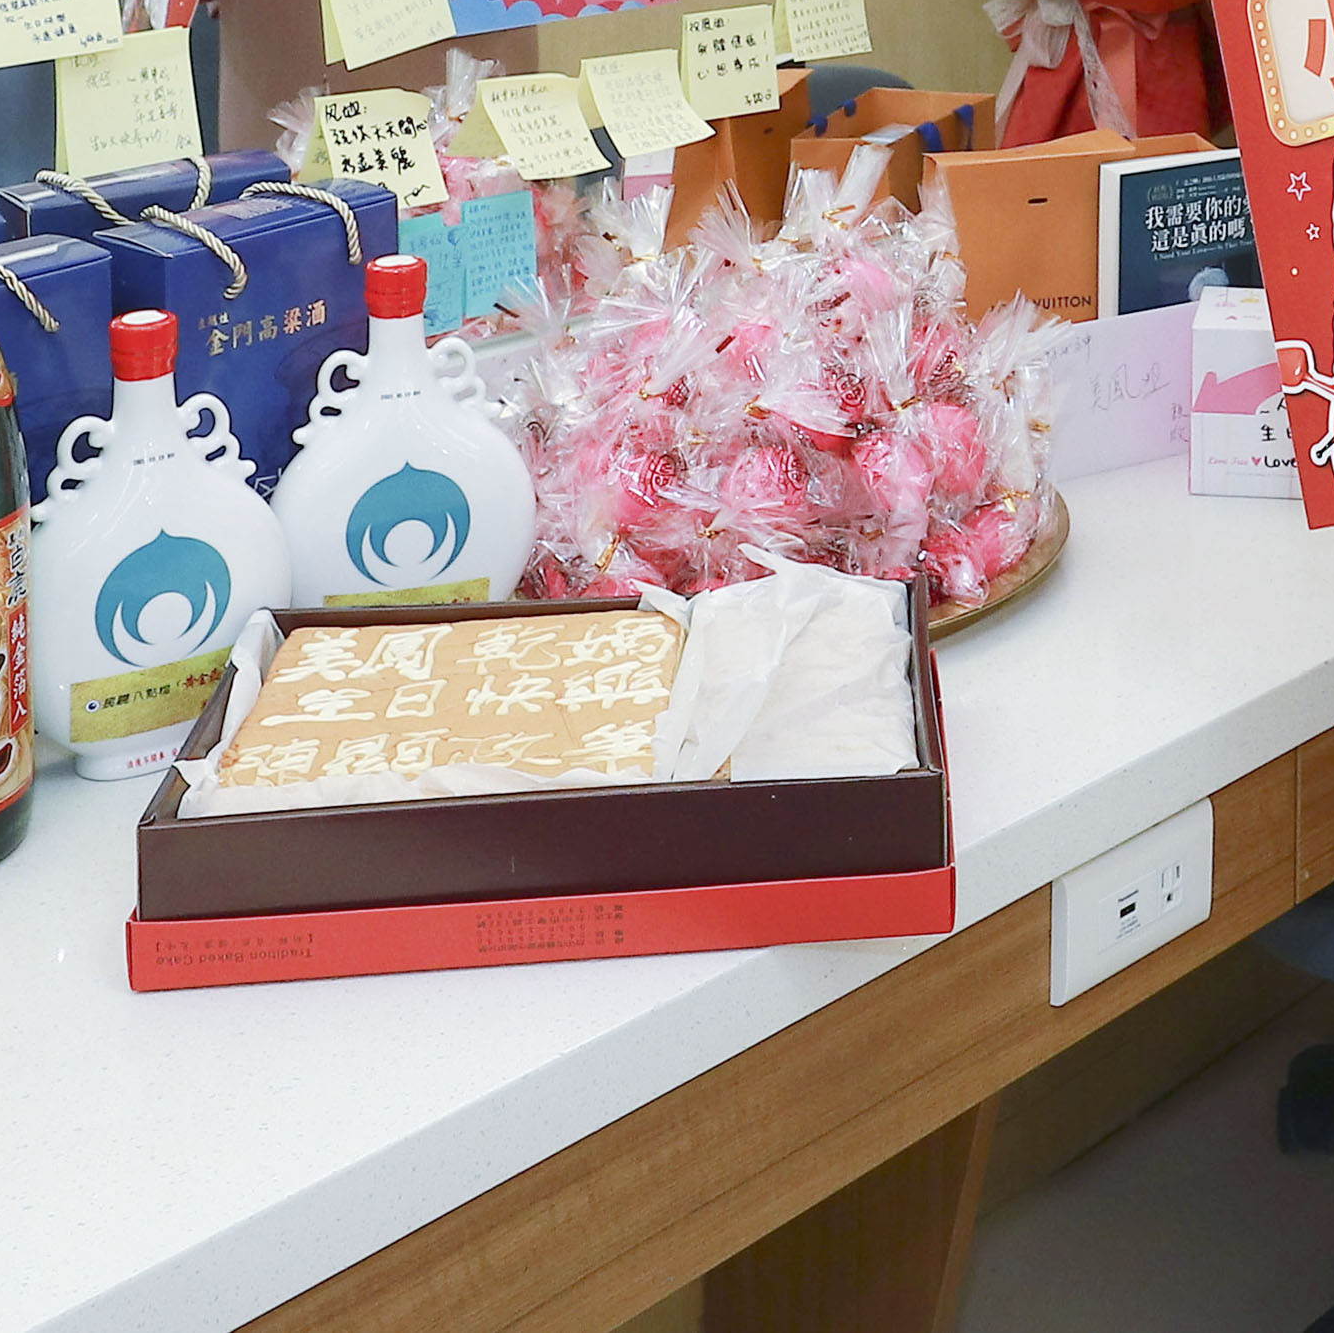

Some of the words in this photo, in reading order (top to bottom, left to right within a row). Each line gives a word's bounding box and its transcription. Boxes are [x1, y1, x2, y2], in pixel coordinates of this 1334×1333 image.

[205, 298, 327, 358] 金門高粱酒
[10, 617, 29, 727] 純金箔入
[259, 659, 672, 727] 生日快樂
[155, 954, 195, 967] Cake
[198, 952, 246, 964] Baked
